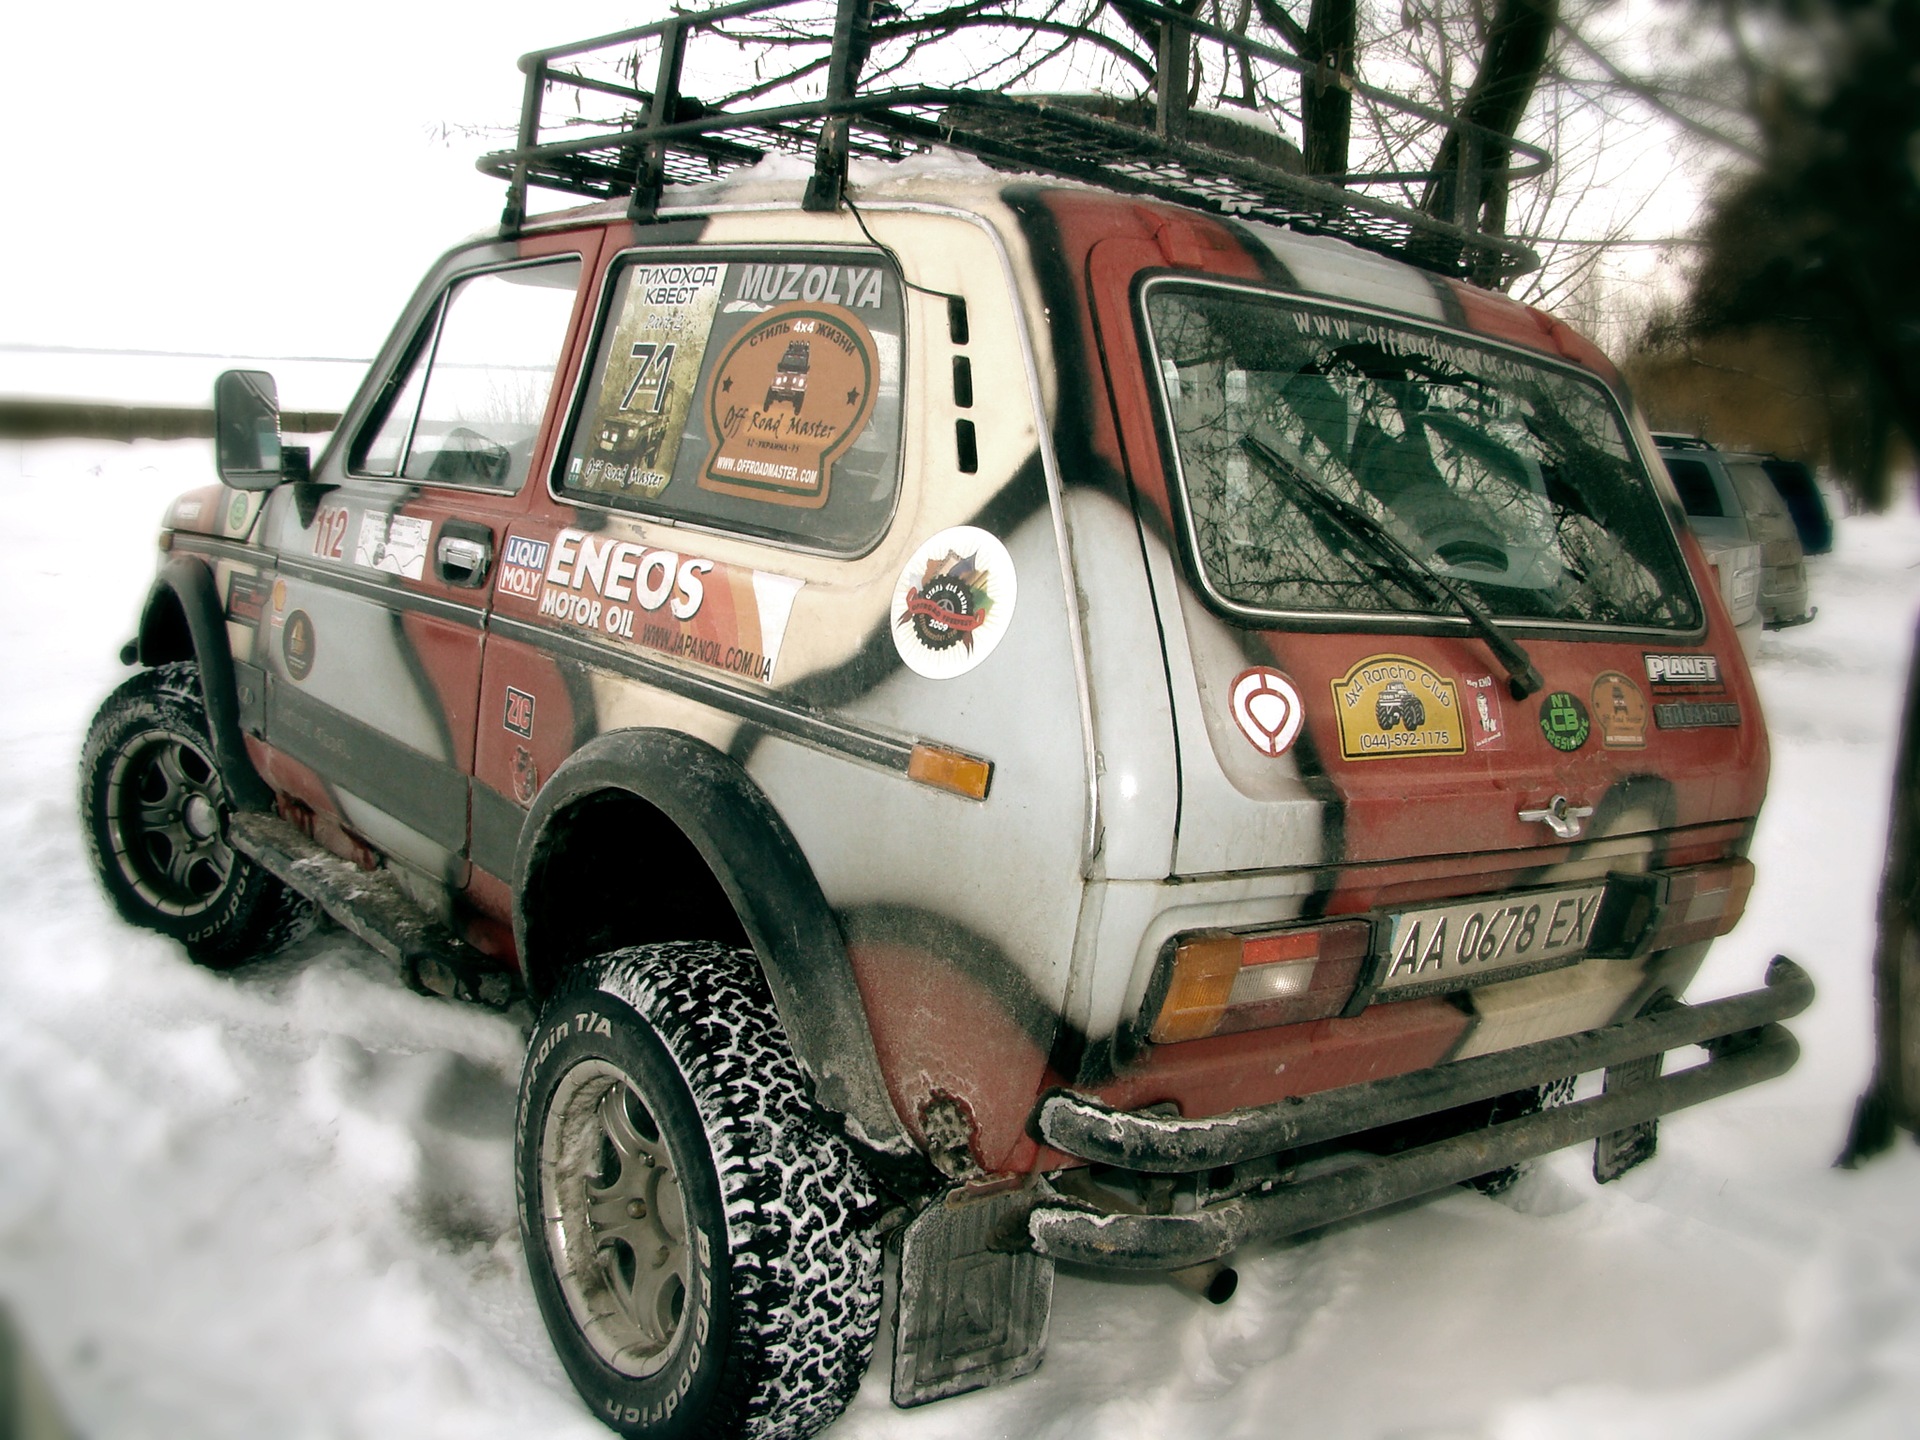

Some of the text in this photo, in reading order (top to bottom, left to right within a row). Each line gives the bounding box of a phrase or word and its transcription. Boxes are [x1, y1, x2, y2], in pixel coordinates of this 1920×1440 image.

[638, 266, 718, 287] ТИХОХОД
[737, 263, 884, 308] MUZOLYA
[643, 286, 700, 305] КВЕСТ
[749, 320, 857, 357] СТИЛЬ 4x4 ЖИЗНИ
[619, 341, 678, 413] 71
[723, 405, 838, 440] Off Road Master
[716, 456, 818, 485] WWW.OFFROADMASTER.COM
[312, 505, 349, 560] 112
[507, 539, 547, 569] LIQUI
[501, 566, 542, 596] MOLY
[546, 529, 714, 621] ENEOS
[541, 588, 635, 639] MOTOR OIL
[929, 618, 949, 632] 2009
[642, 622, 772, 680] WWW.JAPANOIL.COM.UA
[1644, 655, 1717, 682] PLANET
[1344, 664, 1451, 708] 4x4 Rancho Club
[507, 691, 531, 730] ZIC
[1550, 708, 1579, 731] CB
[1360, 731, 1450, 751] (044)-592-1175
[1388, 915, 1448, 978] AA
[1455, 903, 1542, 966] 0678
[1541, 895, 1596, 950] EX
[574, 1010, 613, 1039] T/A
